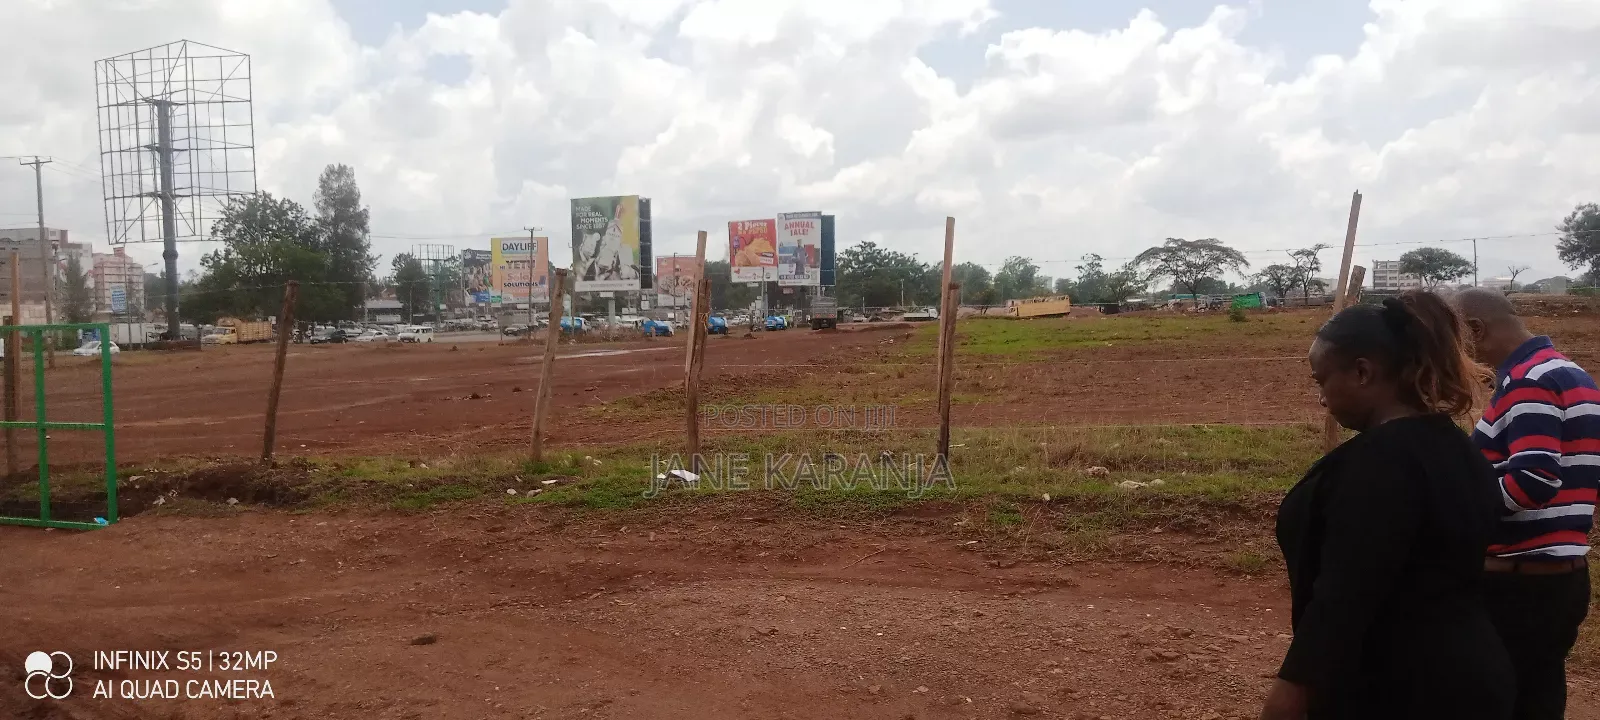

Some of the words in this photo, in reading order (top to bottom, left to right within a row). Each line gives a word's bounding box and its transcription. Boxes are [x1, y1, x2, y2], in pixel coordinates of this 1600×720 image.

[784, 221, 815, 230] ANNUAL
[502, 242, 536, 251] DAYLIFF
[508, 272, 534, 281] Sola
